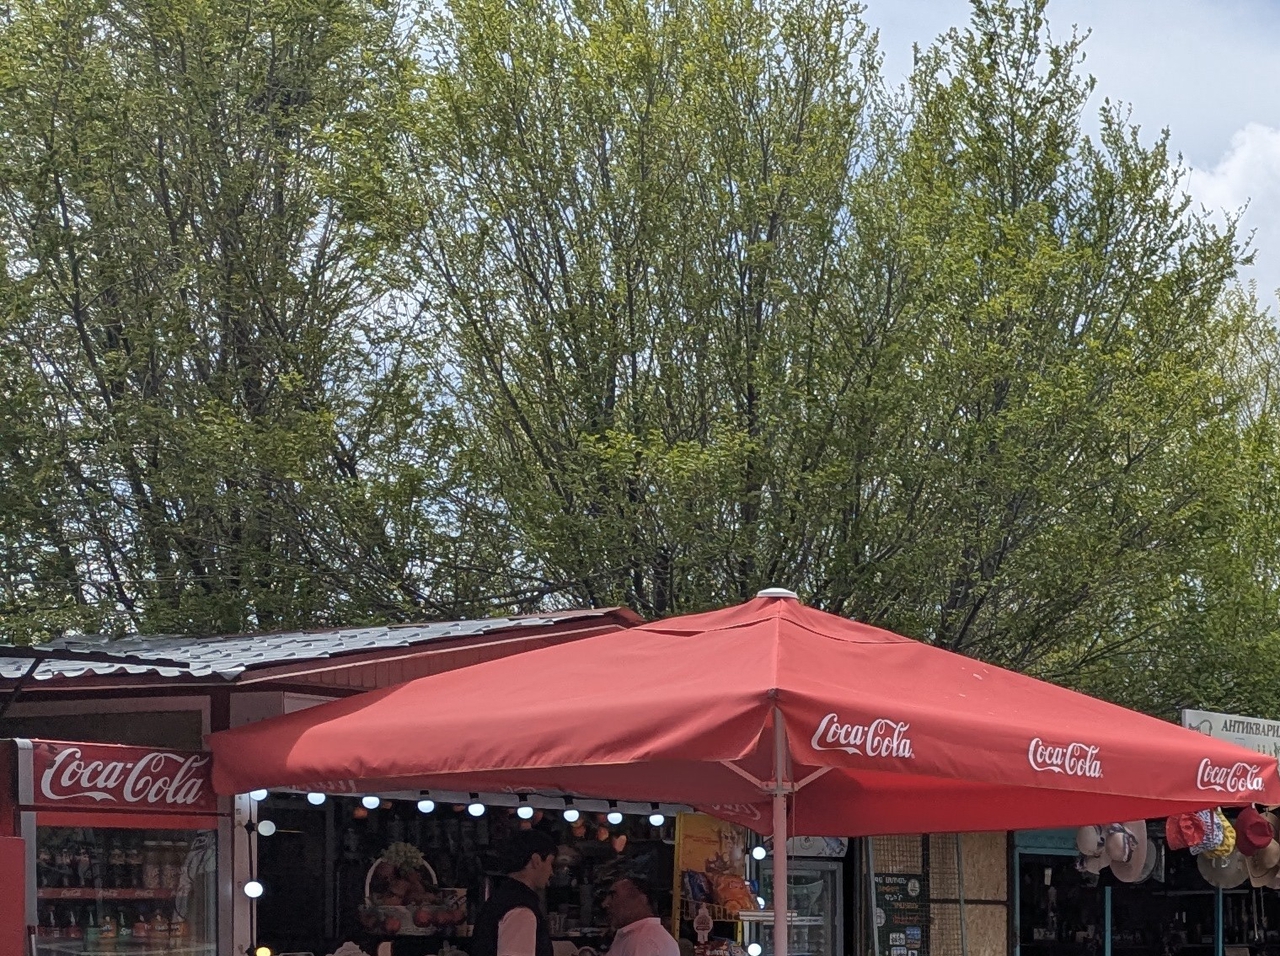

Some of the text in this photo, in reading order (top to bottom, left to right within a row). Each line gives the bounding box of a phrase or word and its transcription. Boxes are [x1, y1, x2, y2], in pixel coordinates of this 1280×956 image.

[811, 713, 911, 758] Coca-Cola
[41, 747, 209, 805] Coca-Cola
[1028, 737, 1101, 778] Coca-Cola
[1197, 758, 1264, 793] Coca-Cola
